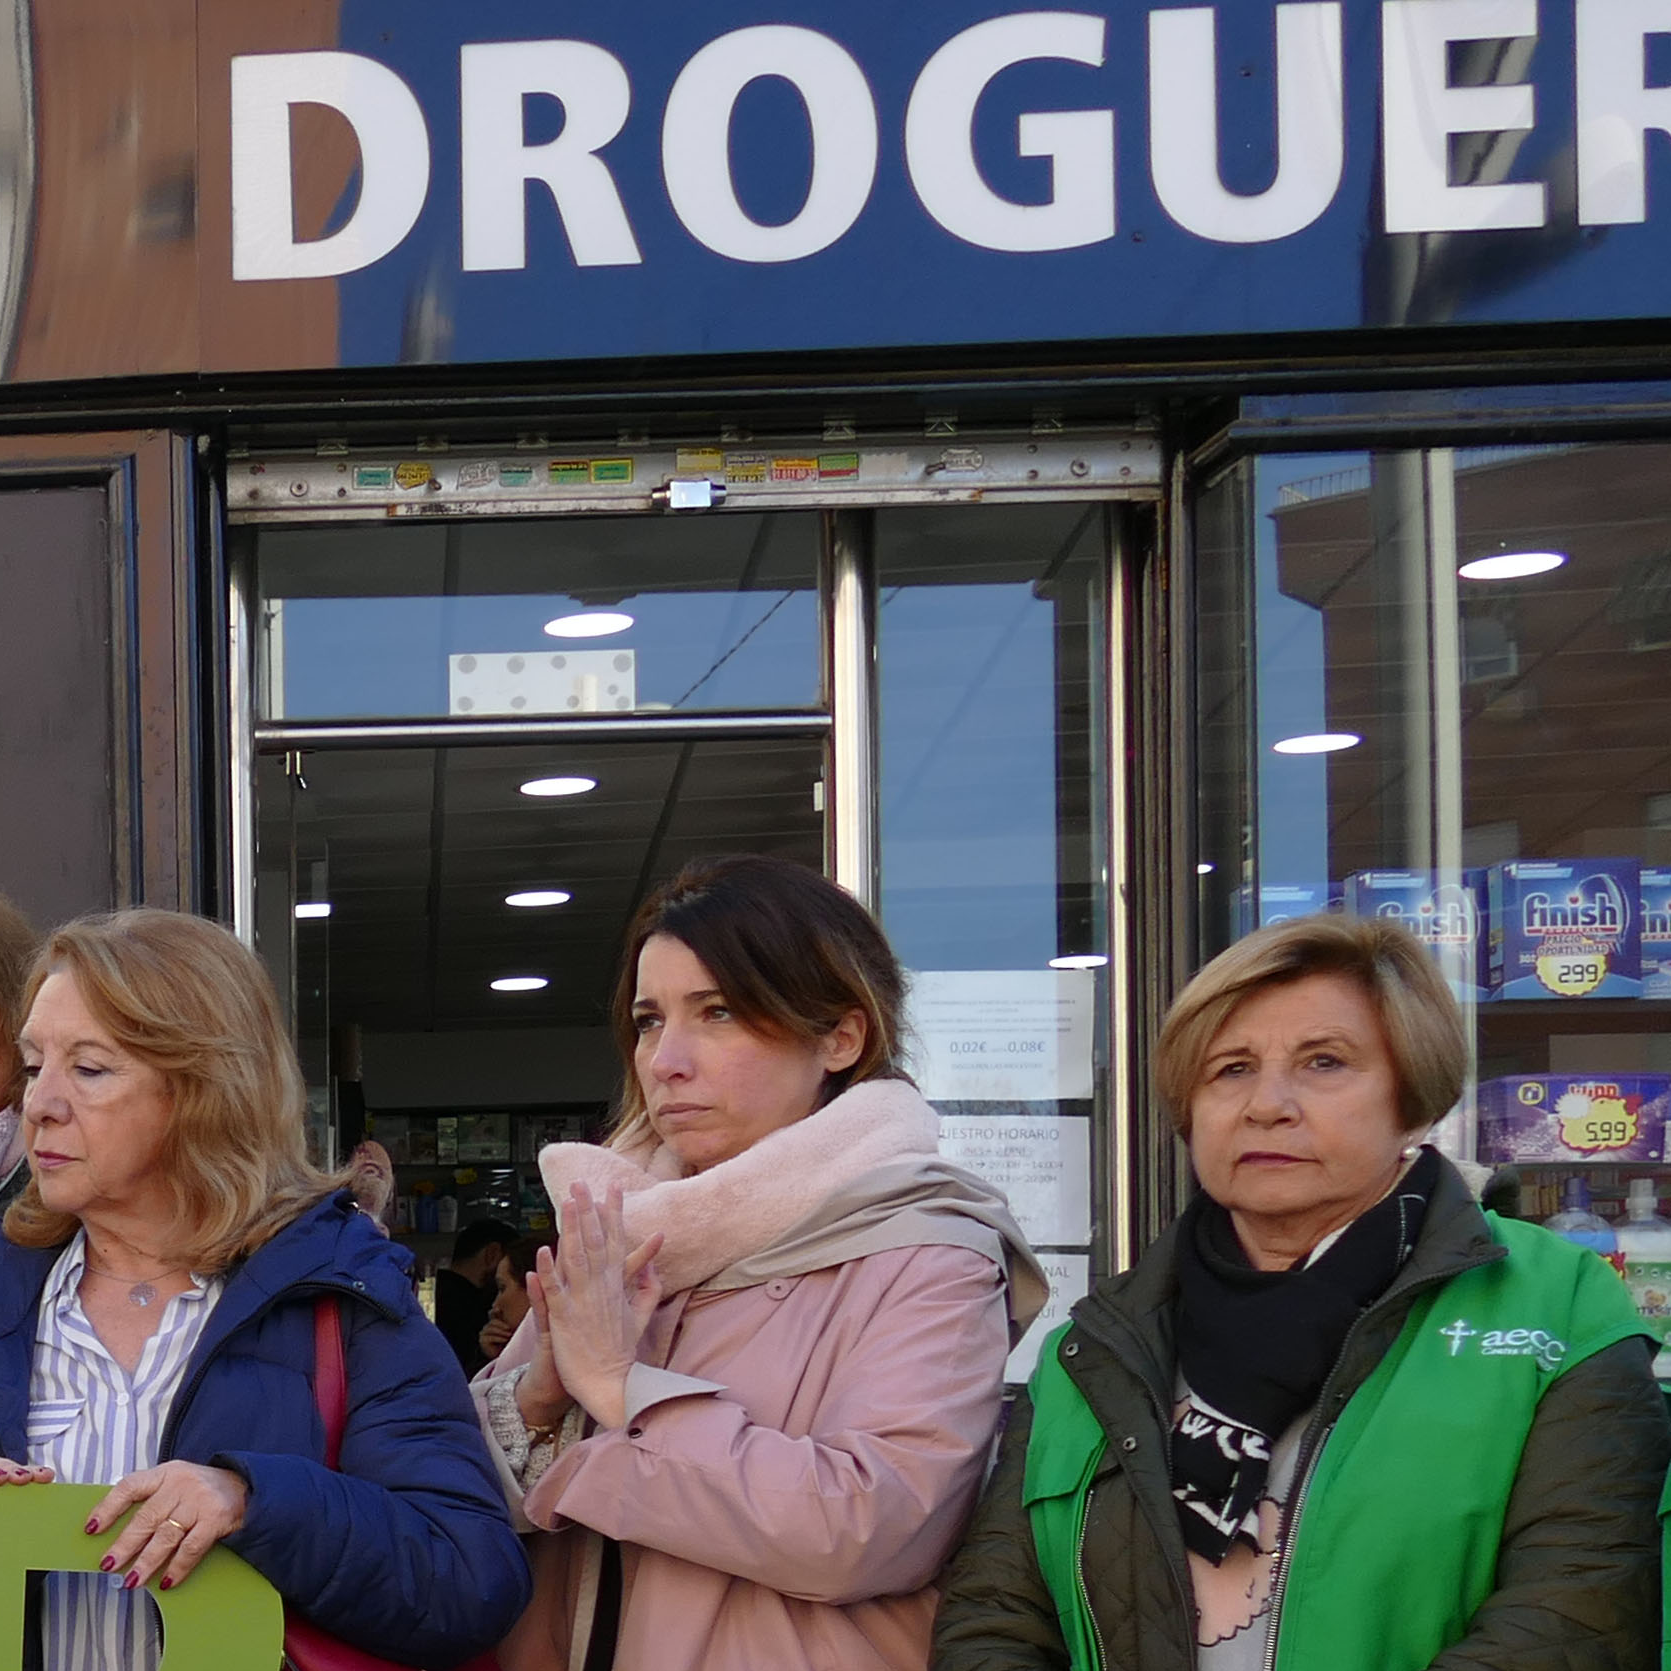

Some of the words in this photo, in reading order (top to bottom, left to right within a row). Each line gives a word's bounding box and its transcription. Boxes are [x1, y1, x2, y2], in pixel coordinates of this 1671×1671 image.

[1523, 892, 1621, 929] finish
[1546, 935, 1582, 945] PRECIO
[1537, 945, 1609, 956] OPORTUNIDAD
[949, 1041, 988, 1055] 0,02€
[1007, 1040, 1046, 1055] 0,08€
[939, 1127, 994, 1141] UESTRO
[998, 1127, 1060, 1141] HORARIO
[1480, 1328, 1567, 1362] aecc
